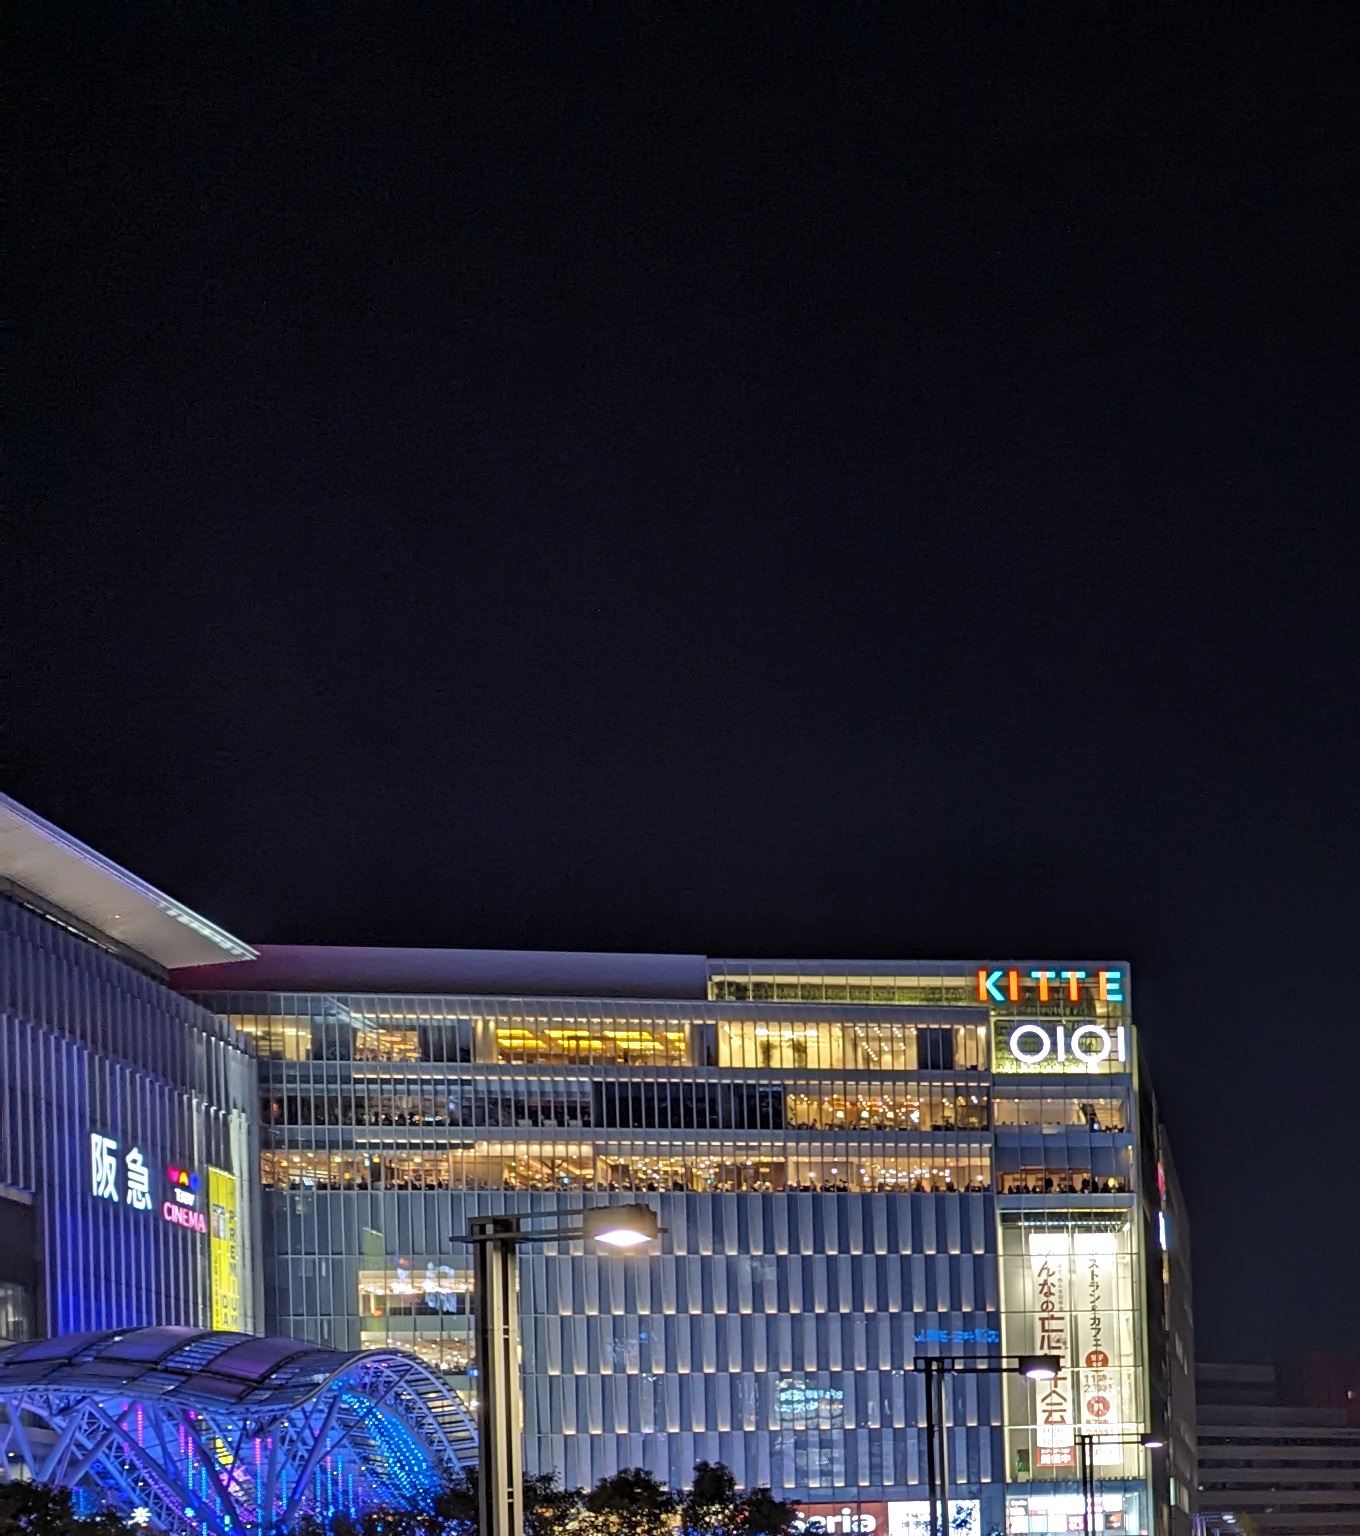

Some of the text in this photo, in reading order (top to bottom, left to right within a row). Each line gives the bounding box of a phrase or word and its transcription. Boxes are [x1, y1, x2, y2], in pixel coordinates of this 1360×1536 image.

[978, 970, 1123, 1002] KITTE
[90, 1132, 153, 1210] 阪急
[163, 1201, 207, 1234] CINEMA
